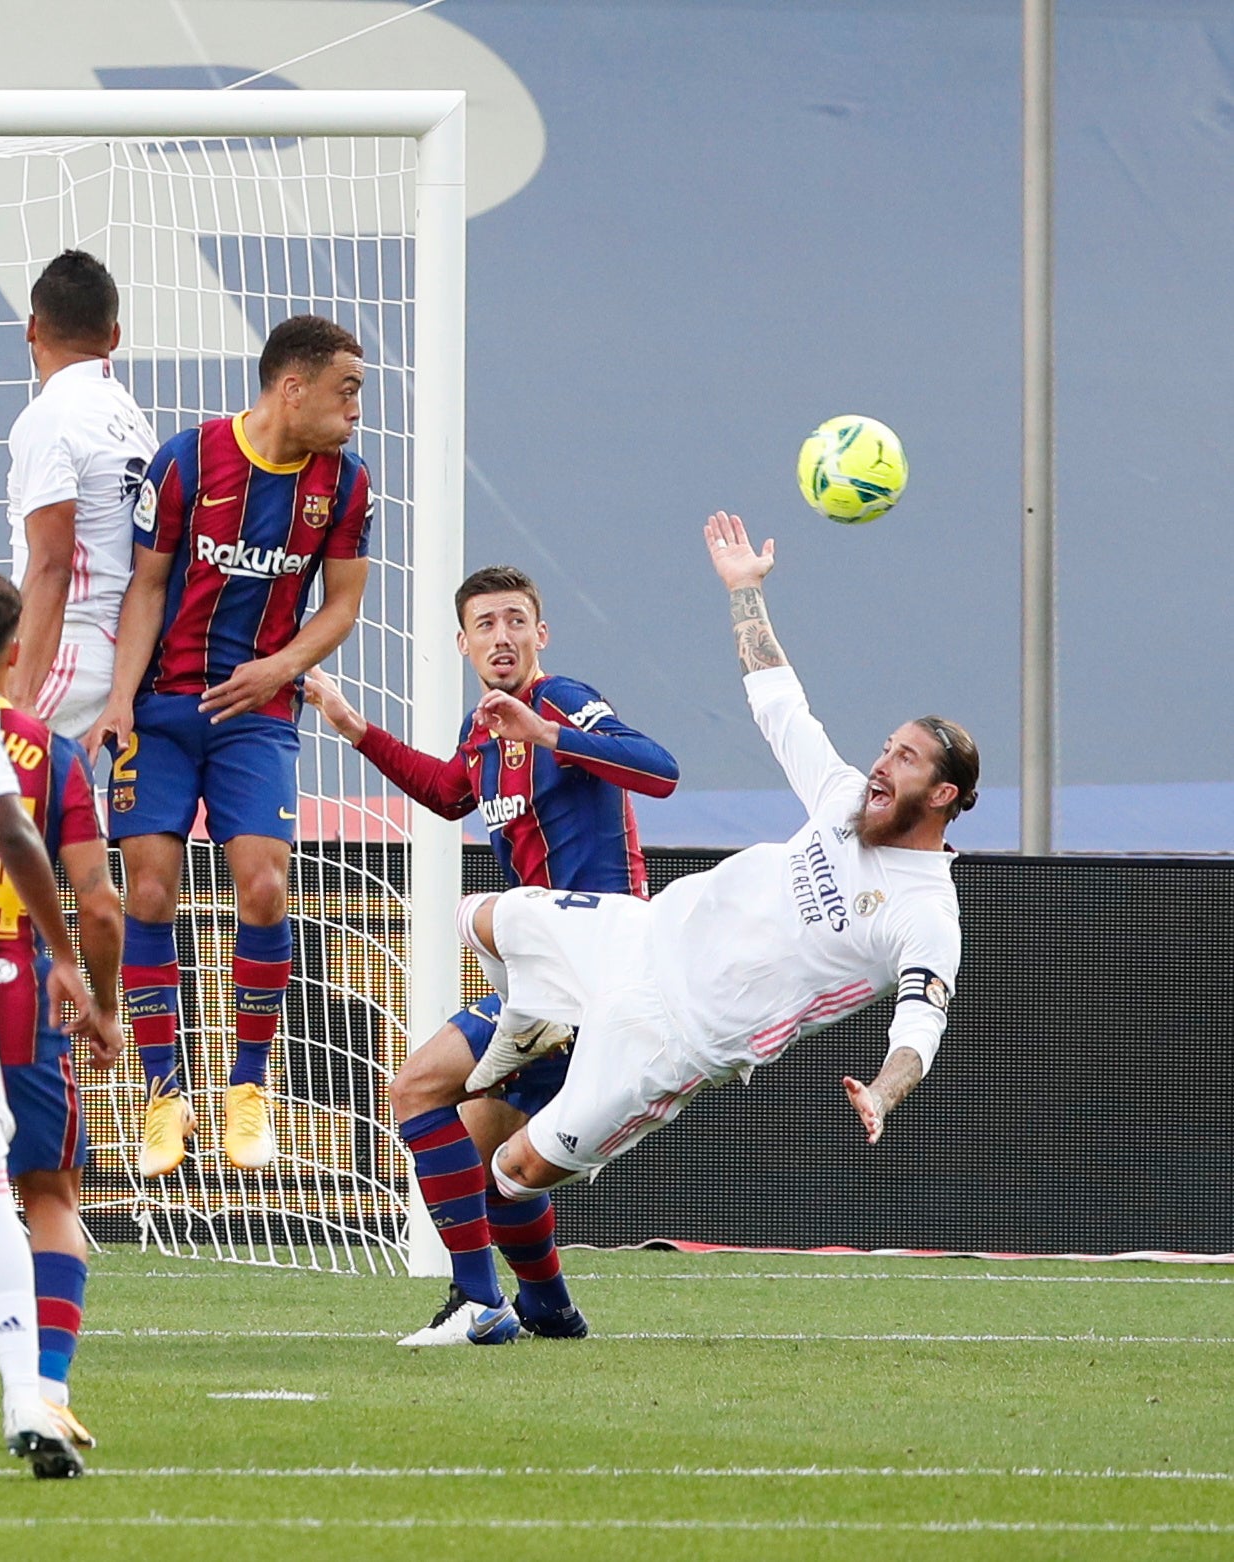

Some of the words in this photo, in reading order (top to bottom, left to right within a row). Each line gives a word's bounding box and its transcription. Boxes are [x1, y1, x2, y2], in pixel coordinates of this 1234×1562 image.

[0, 730, 44, 771] HO
[113, 731, 139, 783] 2
[478, 793, 526, 824] kuten
